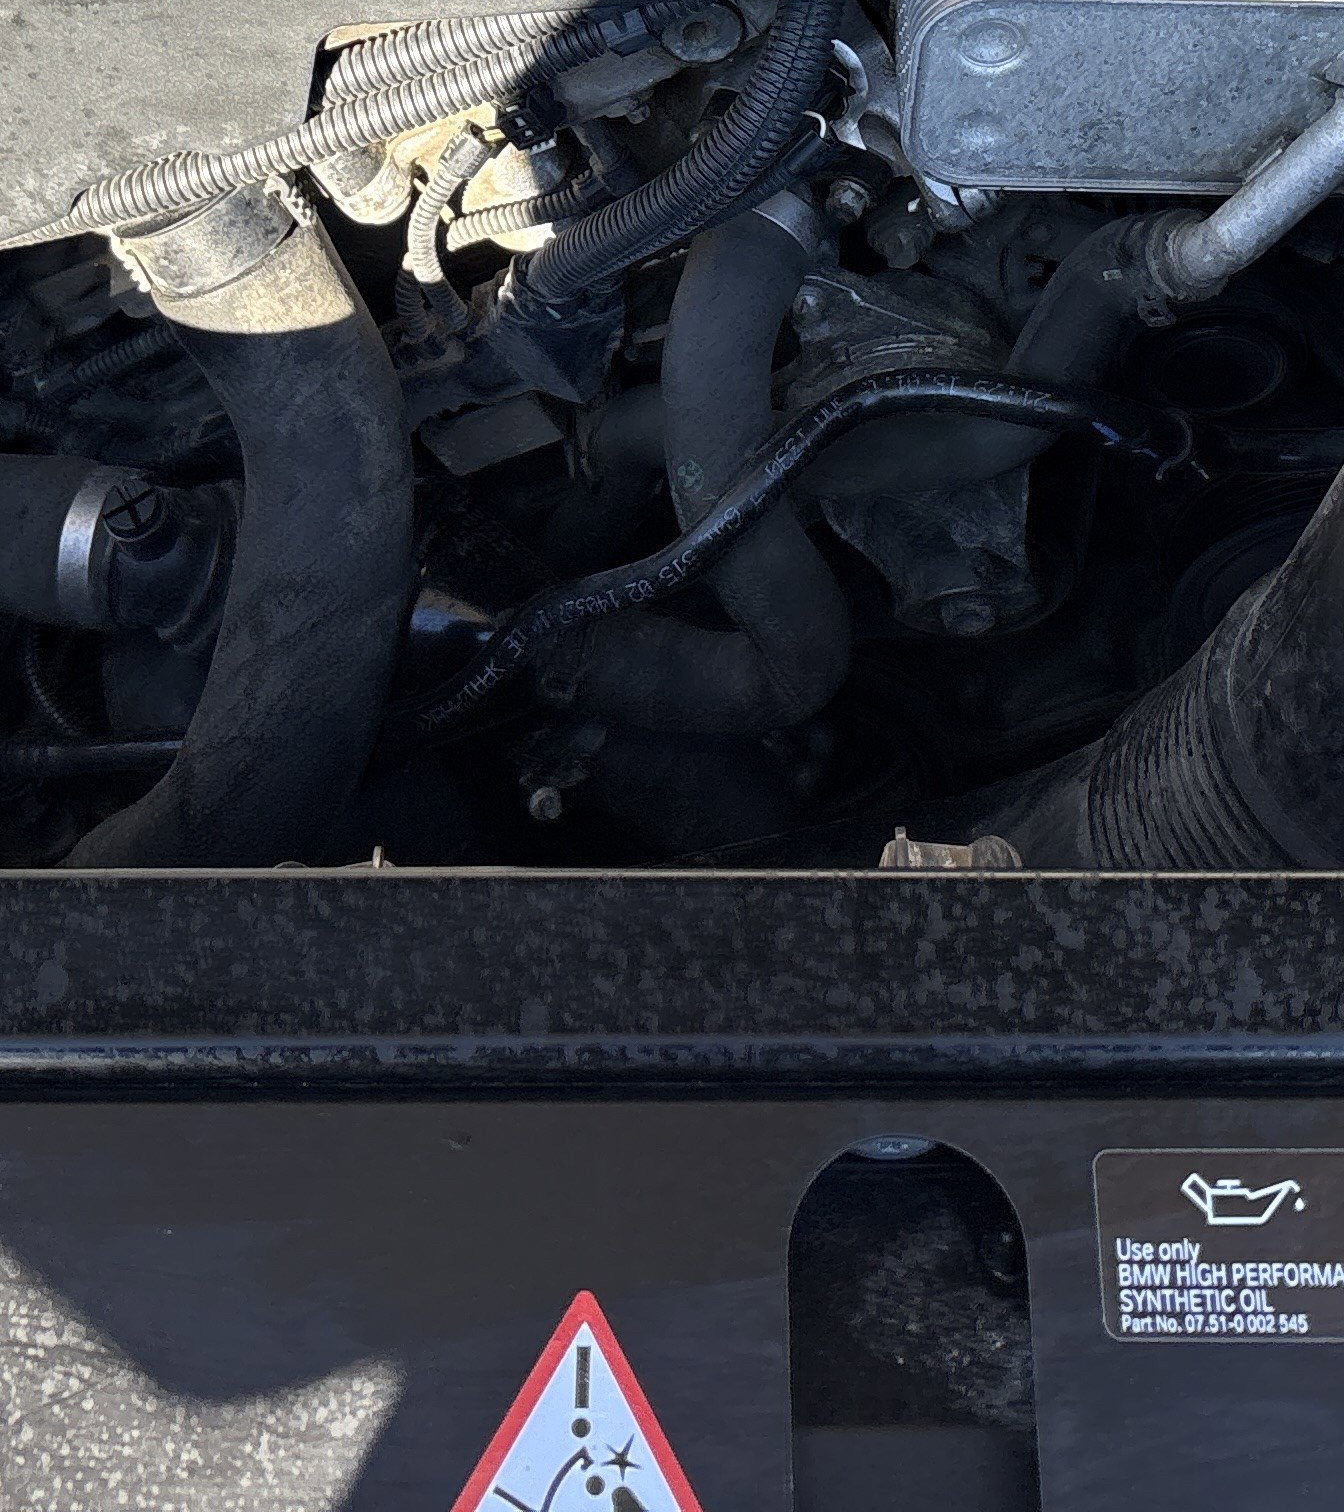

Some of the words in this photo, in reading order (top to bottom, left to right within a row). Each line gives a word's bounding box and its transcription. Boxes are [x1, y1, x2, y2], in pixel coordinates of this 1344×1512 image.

[1116, 1238, 1154, 1260] Use
[1158, 1238, 1200, 1264] only
[1118, 1263, 1171, 1287] BMW
[1175, 1263, 1227, 1286] HIGH
[1119, 1289, 1236, 1313] SYNTHETIC
[1239, 1289, 1276, 1313] OIL
[1121, 1314, 1154, 1334] Part
[1156, 1314, 1183, 1334] No.
[1184, 1314, 1244, 1334] 07.51-0
[1247, 1314, 1277, 1333] 002
[1279, 1314, 1309, 1334] 545
